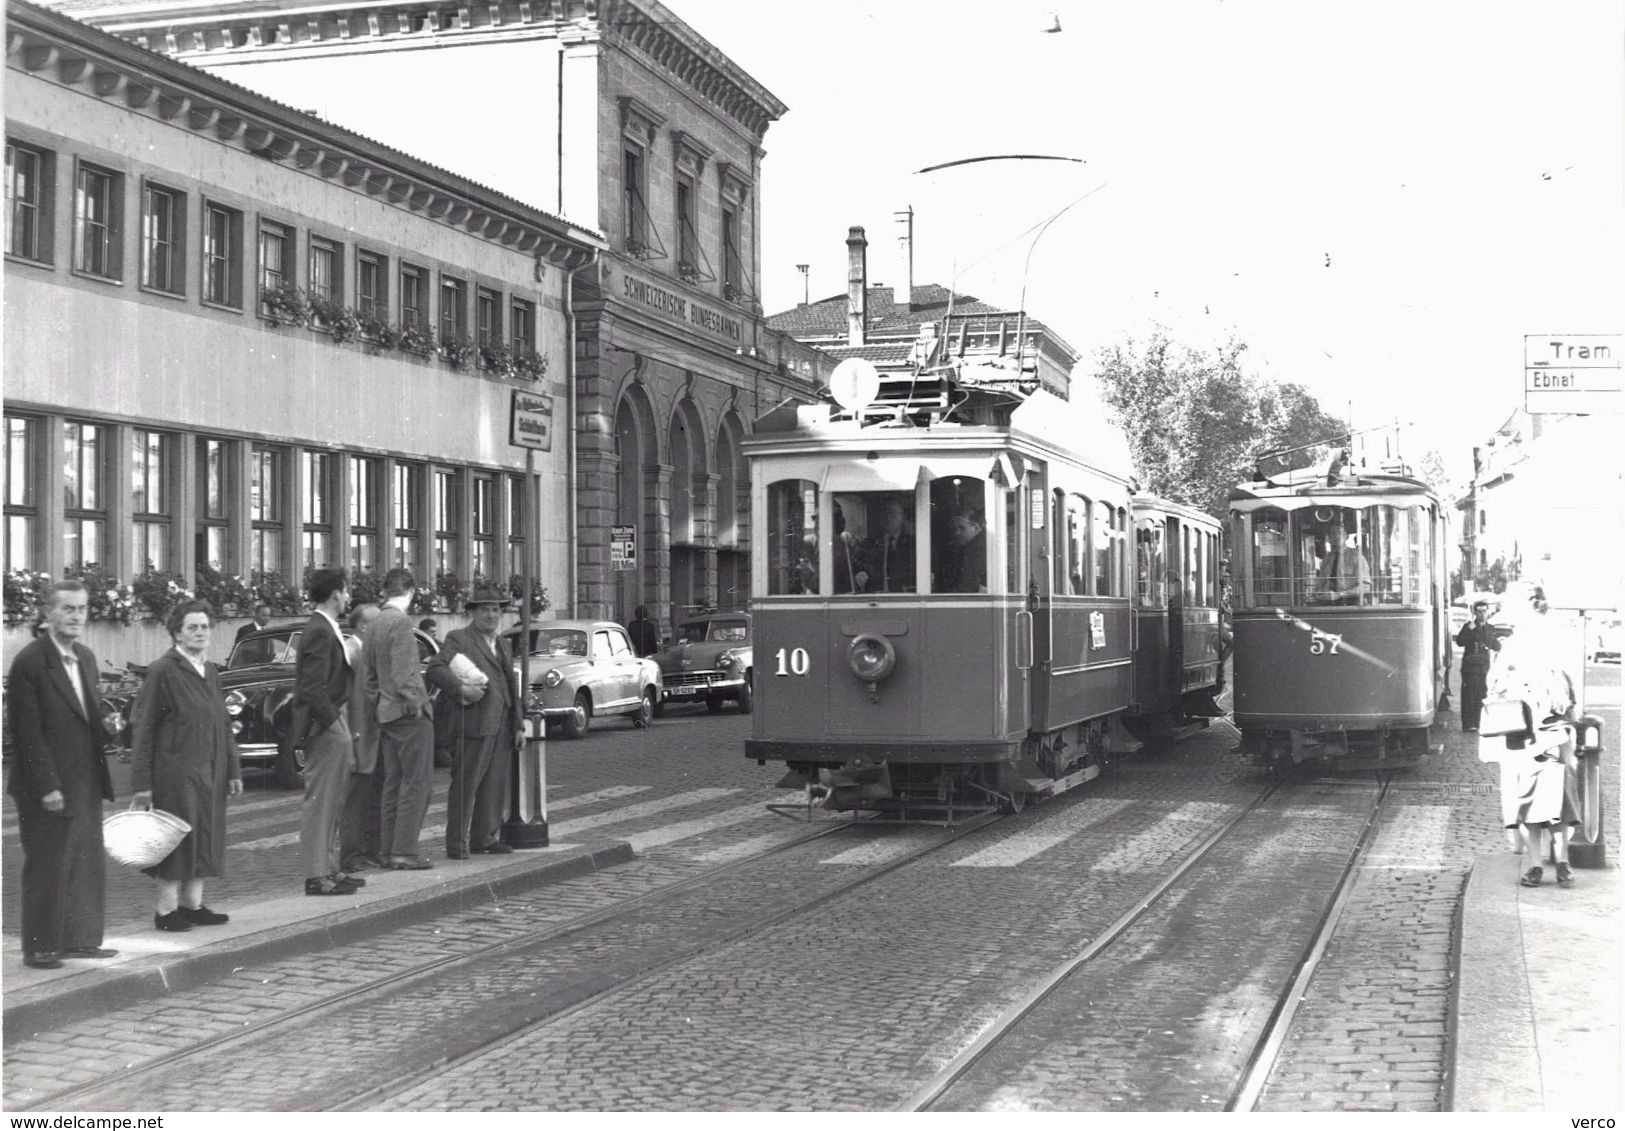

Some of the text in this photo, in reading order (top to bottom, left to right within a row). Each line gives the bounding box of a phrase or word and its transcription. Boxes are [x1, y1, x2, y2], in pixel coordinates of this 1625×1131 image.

[623, 274, 740, 341] SCHWEIZERISCHE BUNDESBAHNEN
[1549, 342, 1611, 359] Tram
[1533, 371, 1575, 387] Ebnat
[624, 541, 634, 558] P
[1310, 627, 1343, 655] 57
[775, 647, 810, 676] 10
